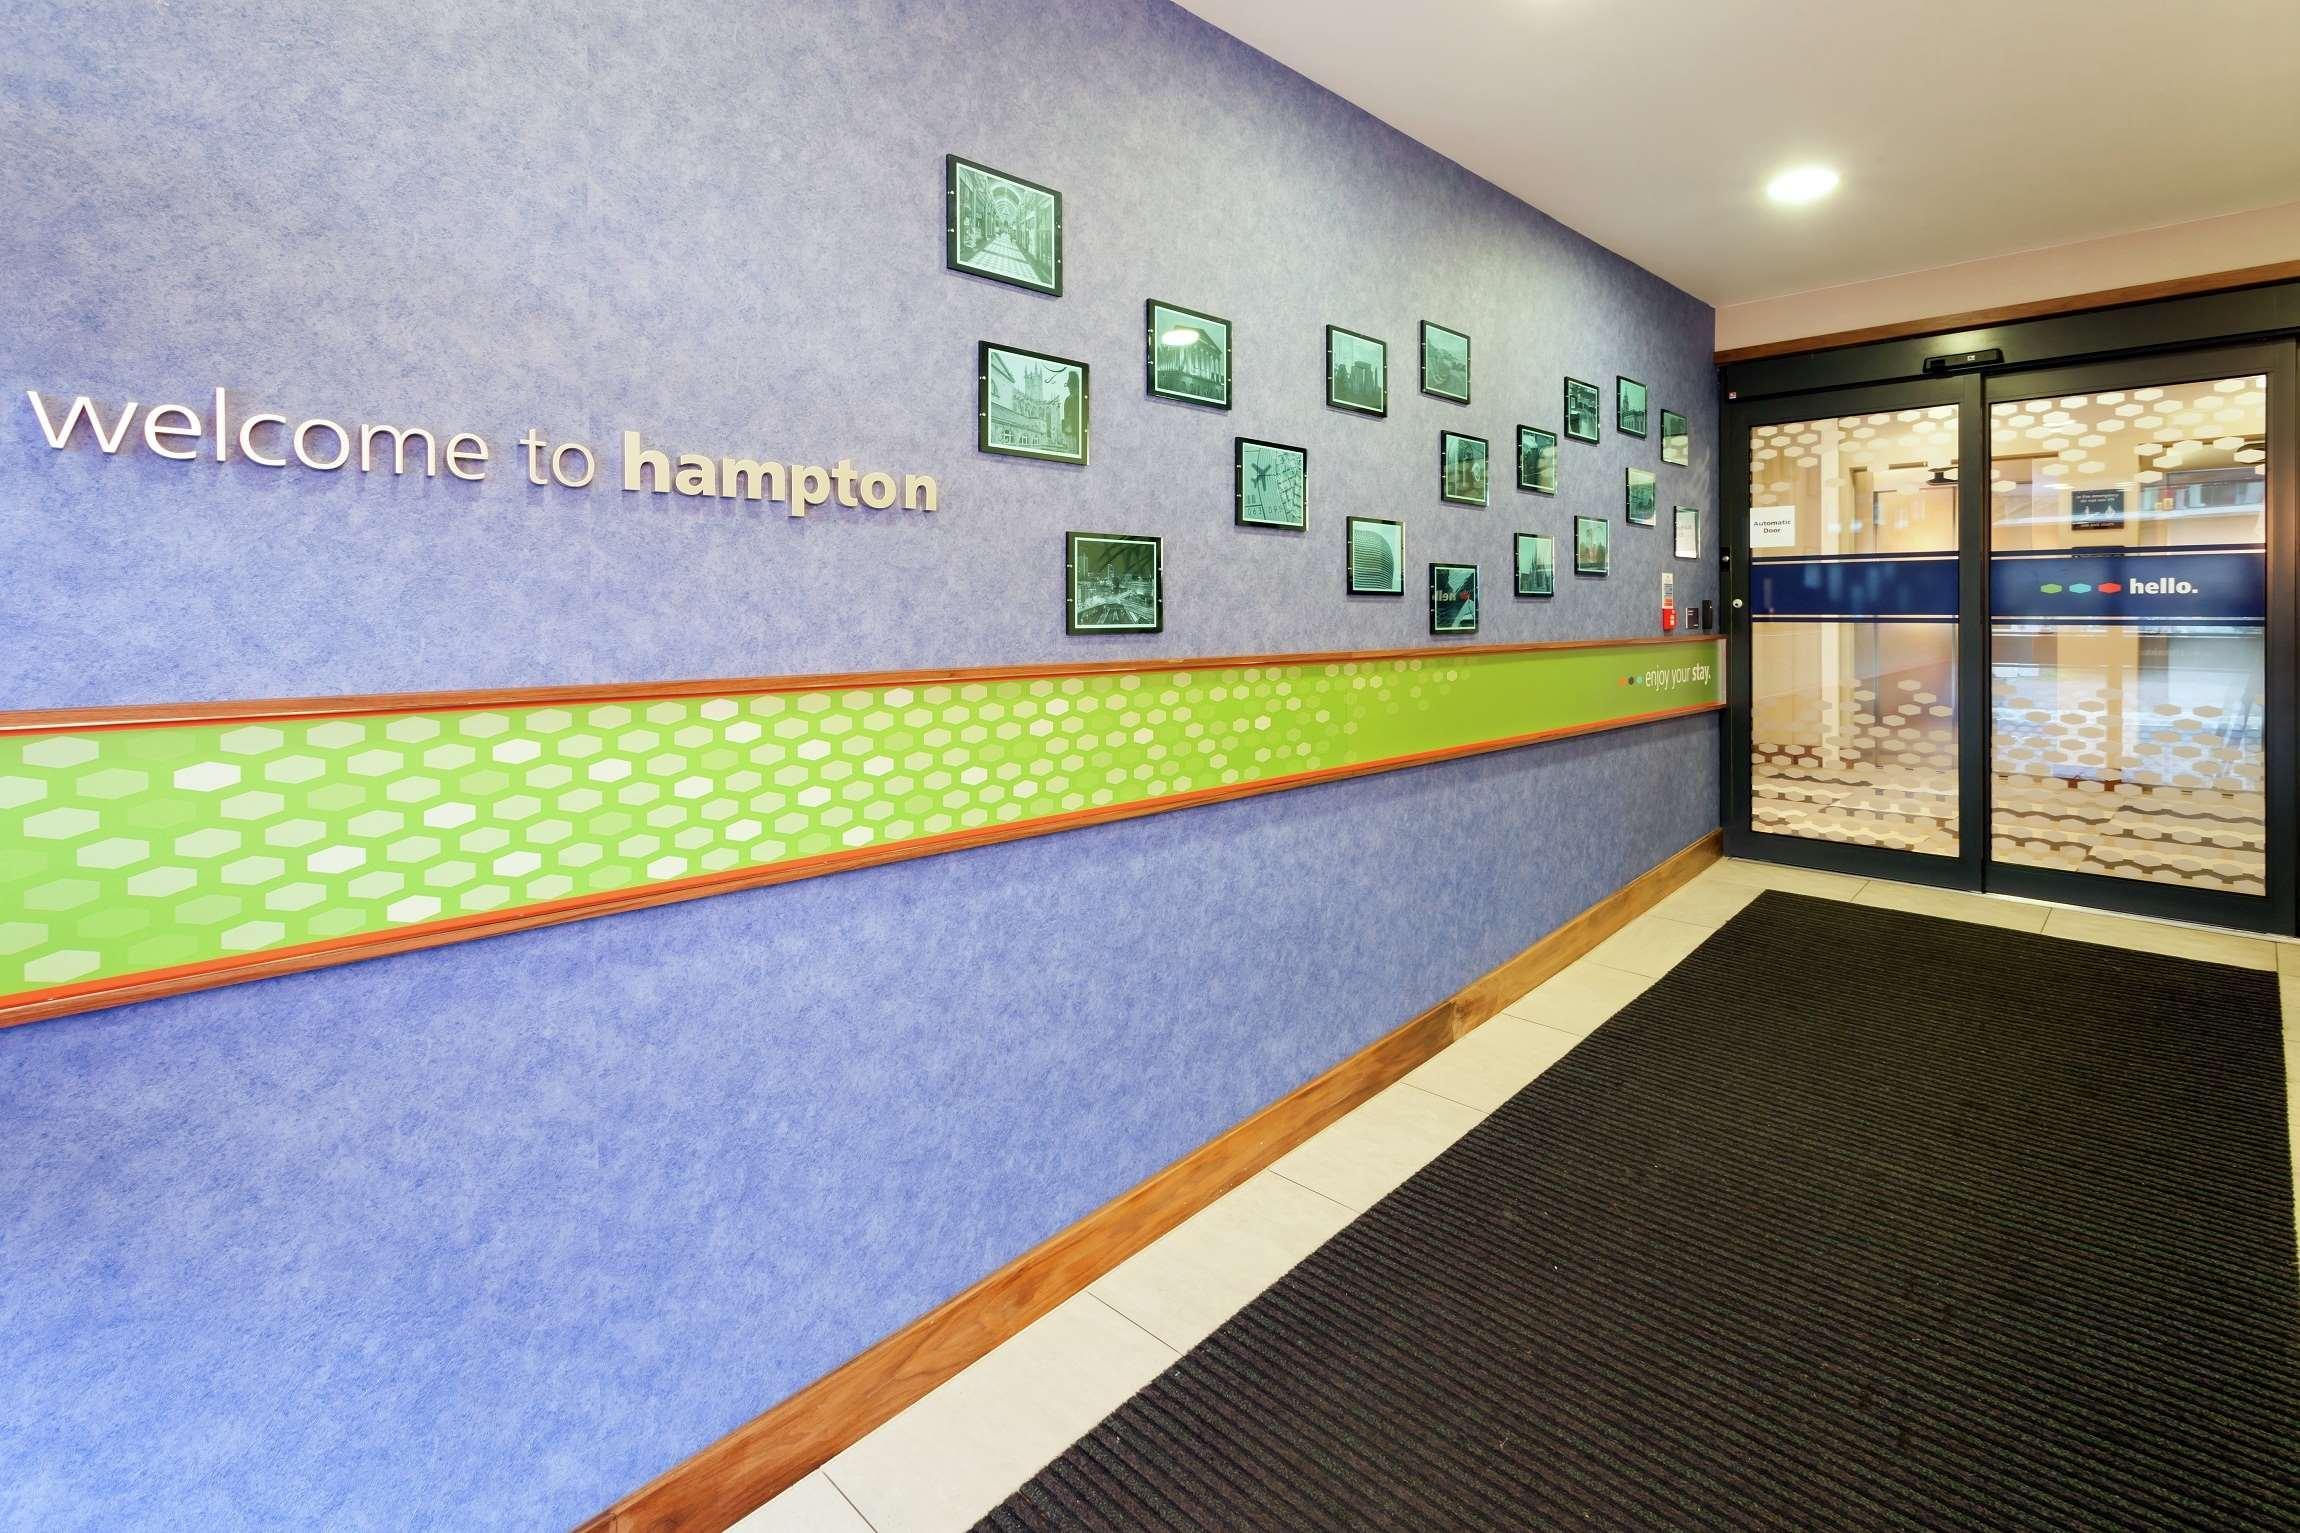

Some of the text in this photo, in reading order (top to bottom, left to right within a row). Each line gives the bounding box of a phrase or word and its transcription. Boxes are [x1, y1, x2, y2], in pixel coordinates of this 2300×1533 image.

[27, 387, 938, 517] welcome to hampton
[2129, 577, 2199, 595] hello.
[1645, 662, 1711, 692] enjoy your stay.
